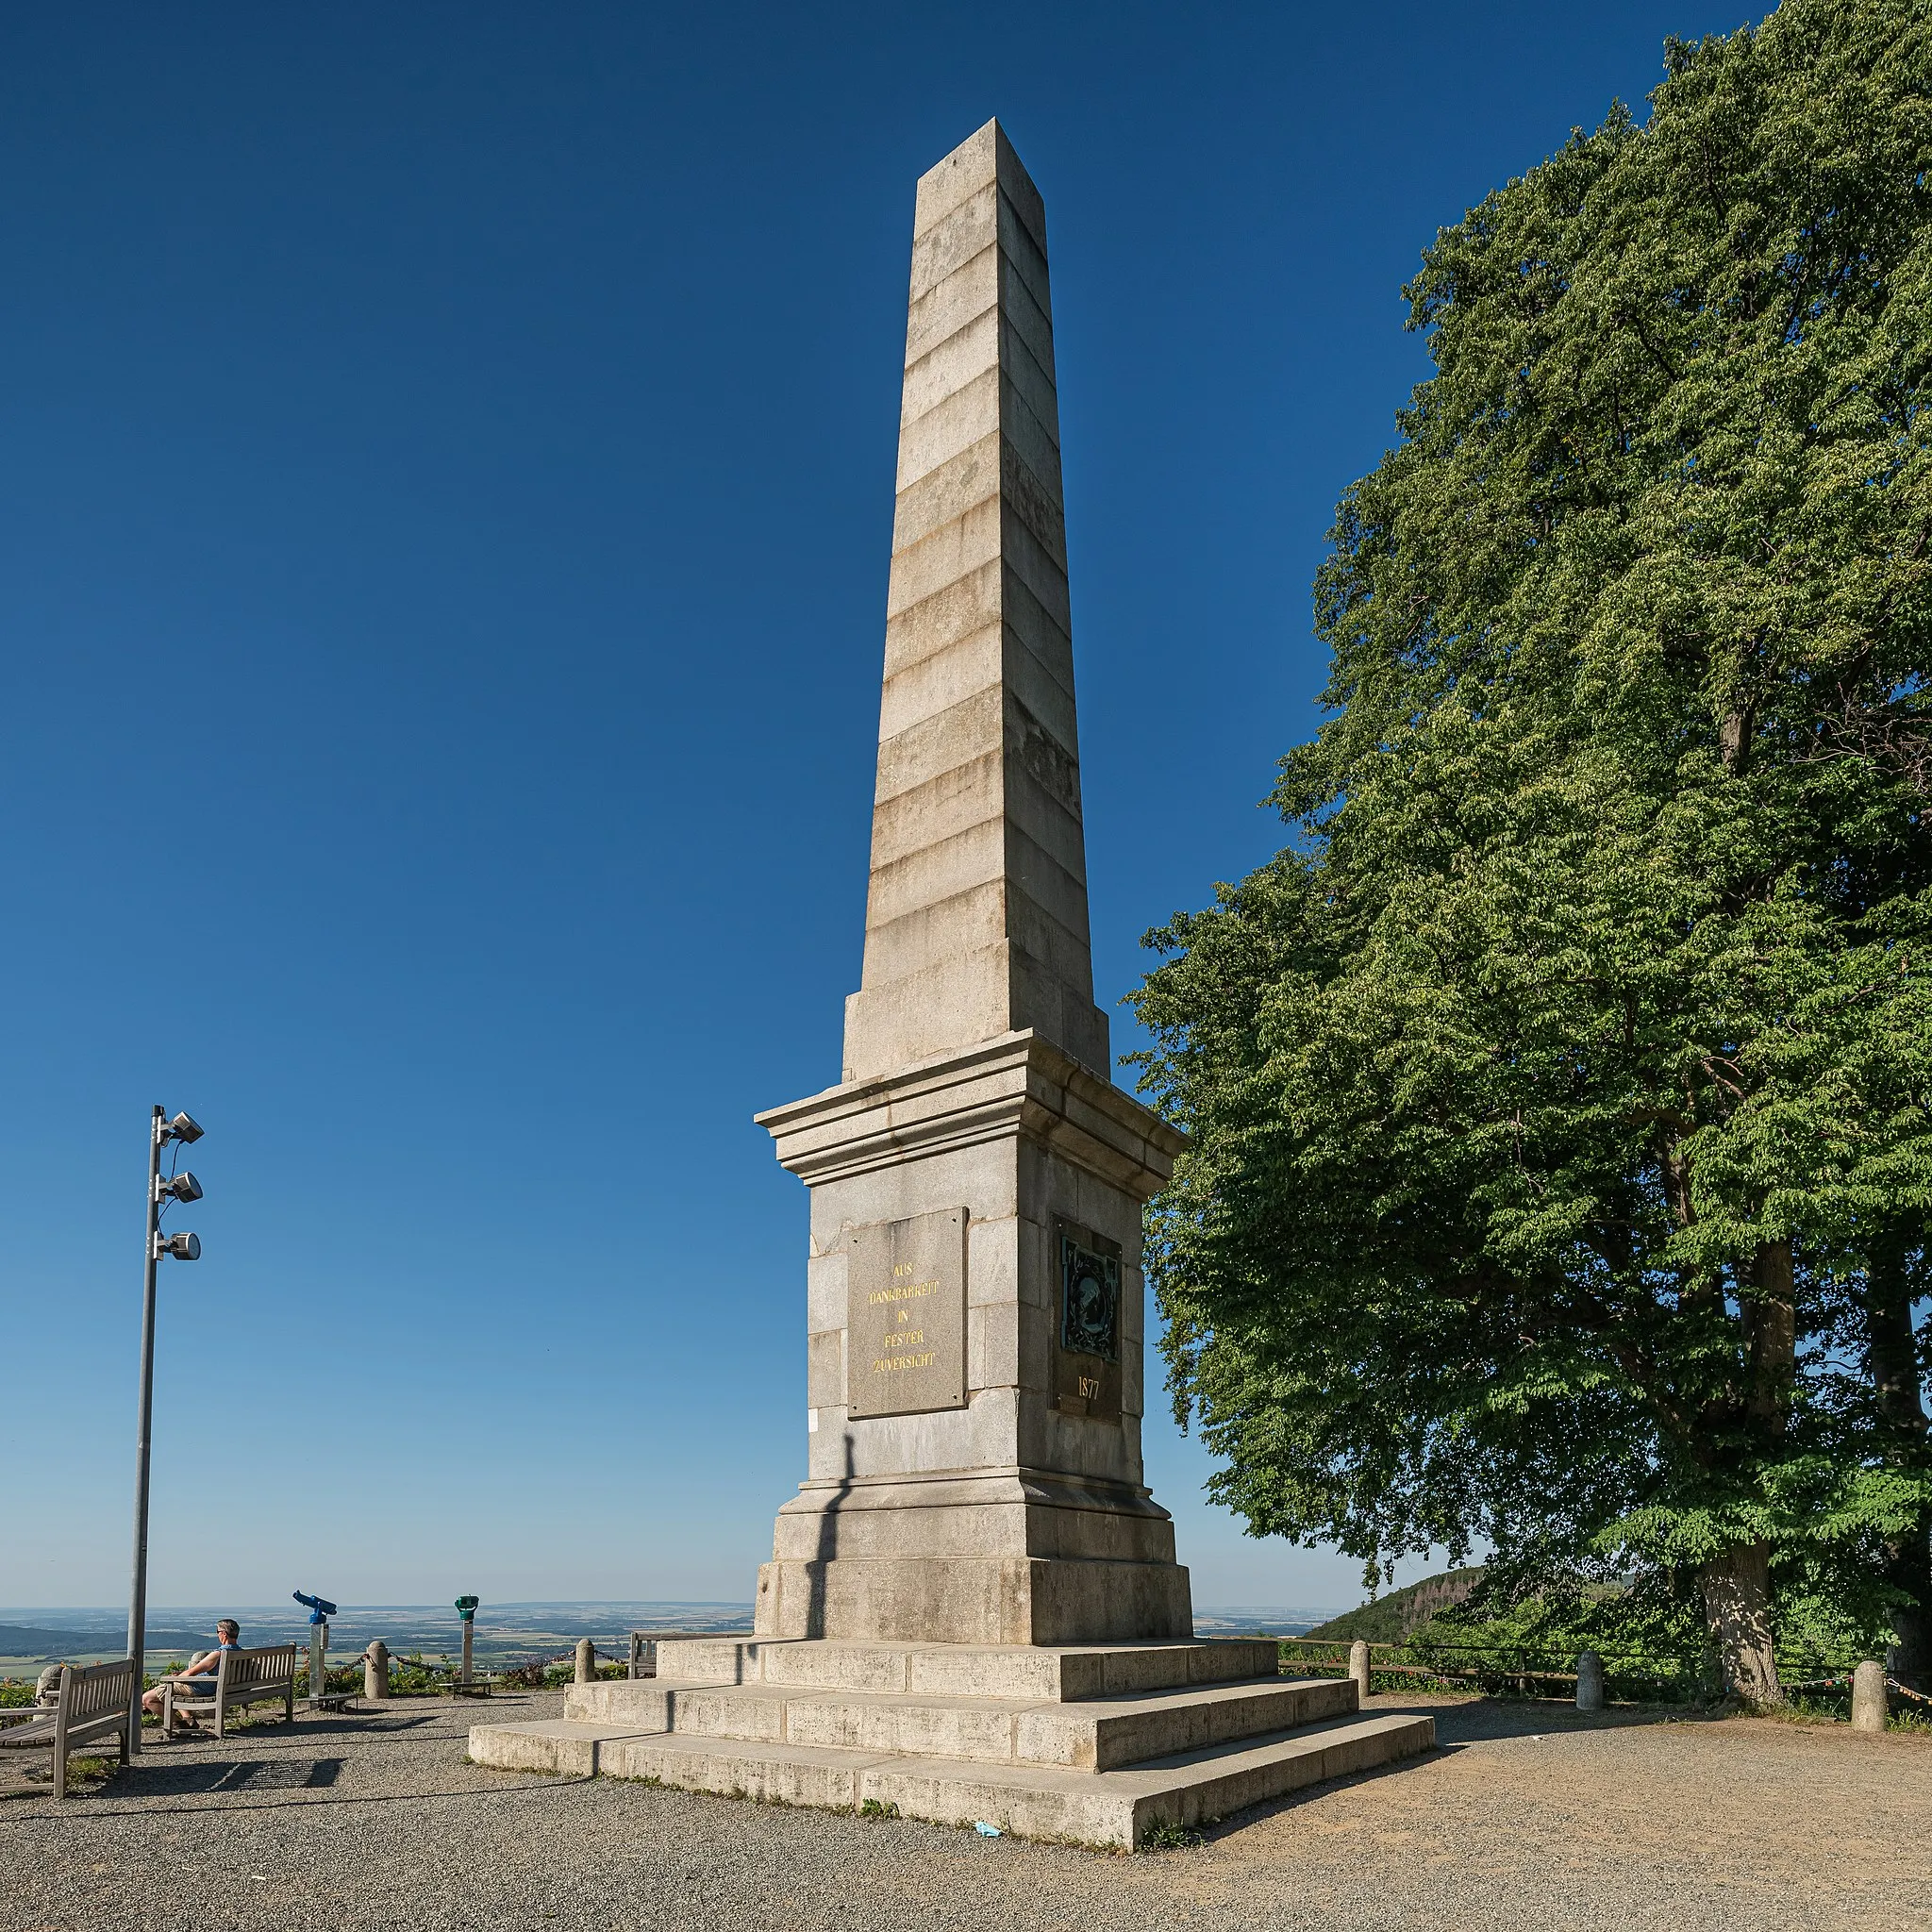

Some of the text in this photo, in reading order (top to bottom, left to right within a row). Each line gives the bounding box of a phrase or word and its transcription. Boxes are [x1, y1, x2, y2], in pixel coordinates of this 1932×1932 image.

[892, 1262, 912, 1277] AUS
[869, 1280, 939, 1305] DANKBARKEIT
[898, 1309, 908, 1323] IN
[885, 1329, 924, 1347] FESTER
[873, 1352, 935, 1373] ZUVERSICHT
[1078, 1375, 1099, 1400] 1877
